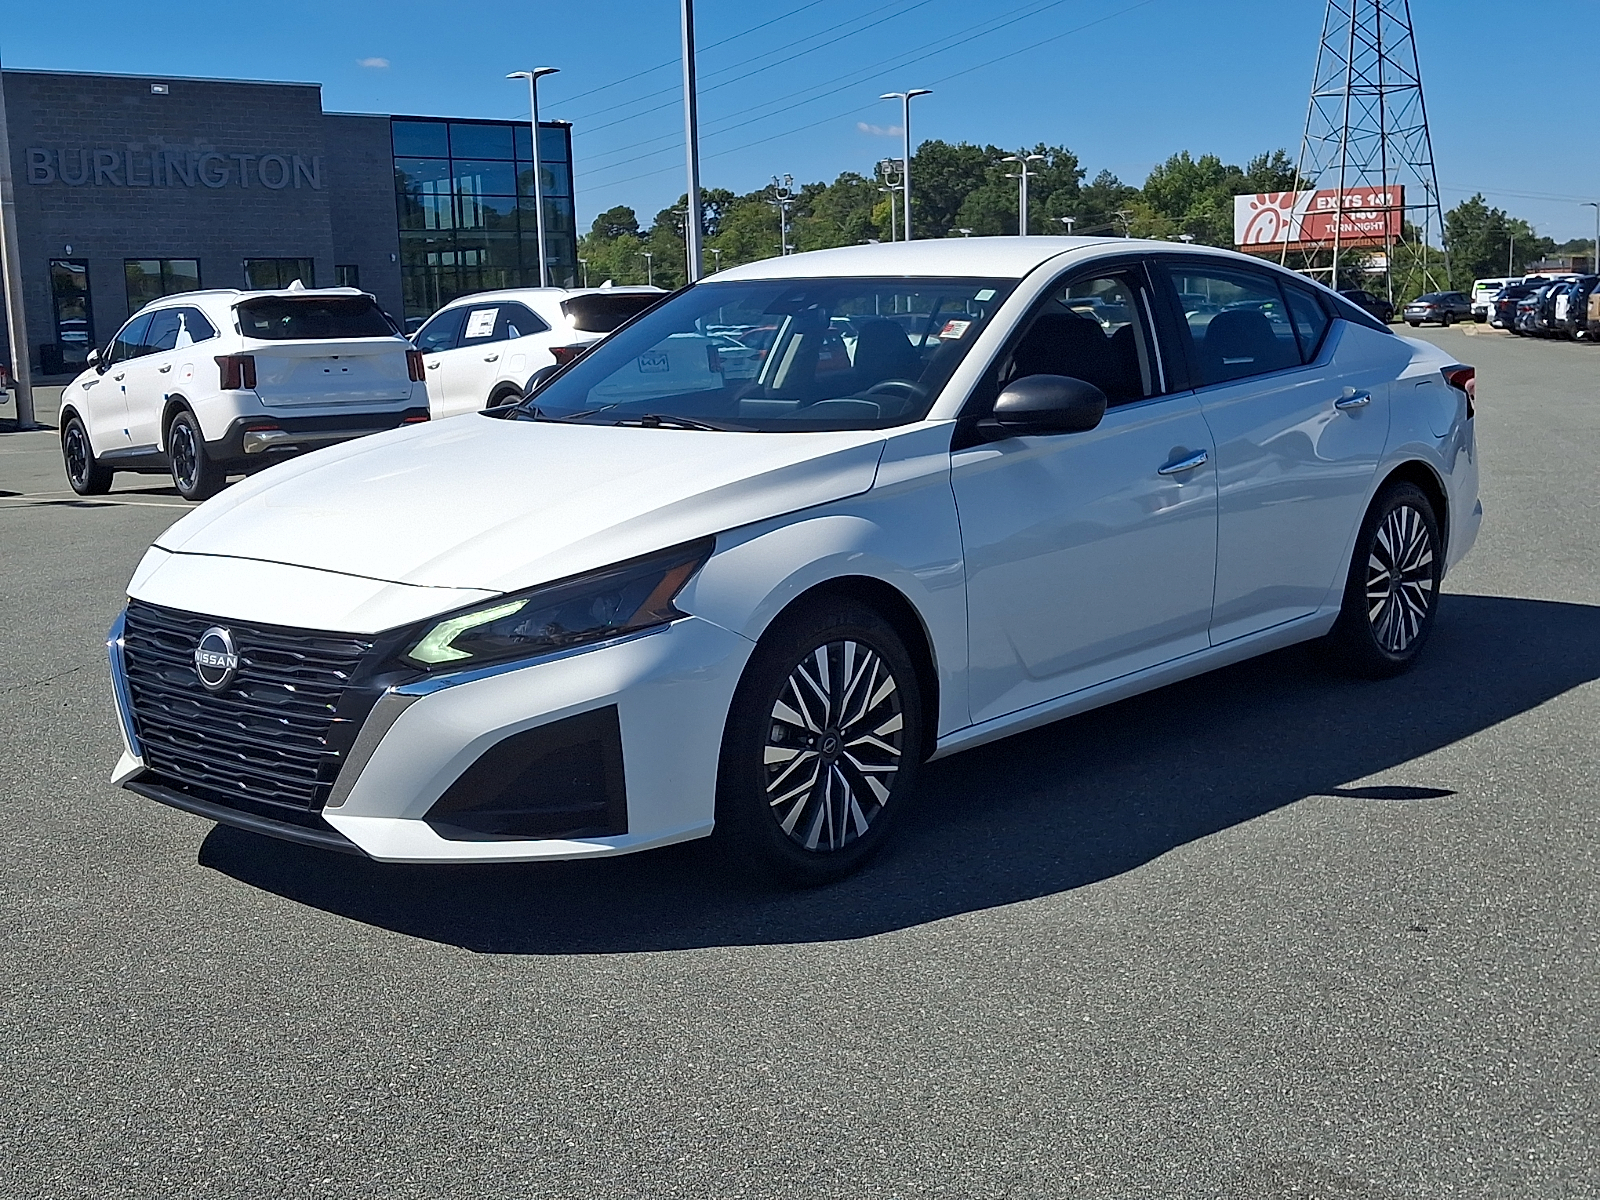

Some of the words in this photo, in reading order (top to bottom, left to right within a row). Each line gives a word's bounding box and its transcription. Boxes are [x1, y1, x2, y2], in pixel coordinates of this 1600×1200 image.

[25, 146, 322, 190] BURLINGTON
[1317, 194, 1362, 209] EXTS
[1354, 221, 1384, 231] RIGHT
[195, 650, 237, 668] NISSAN
